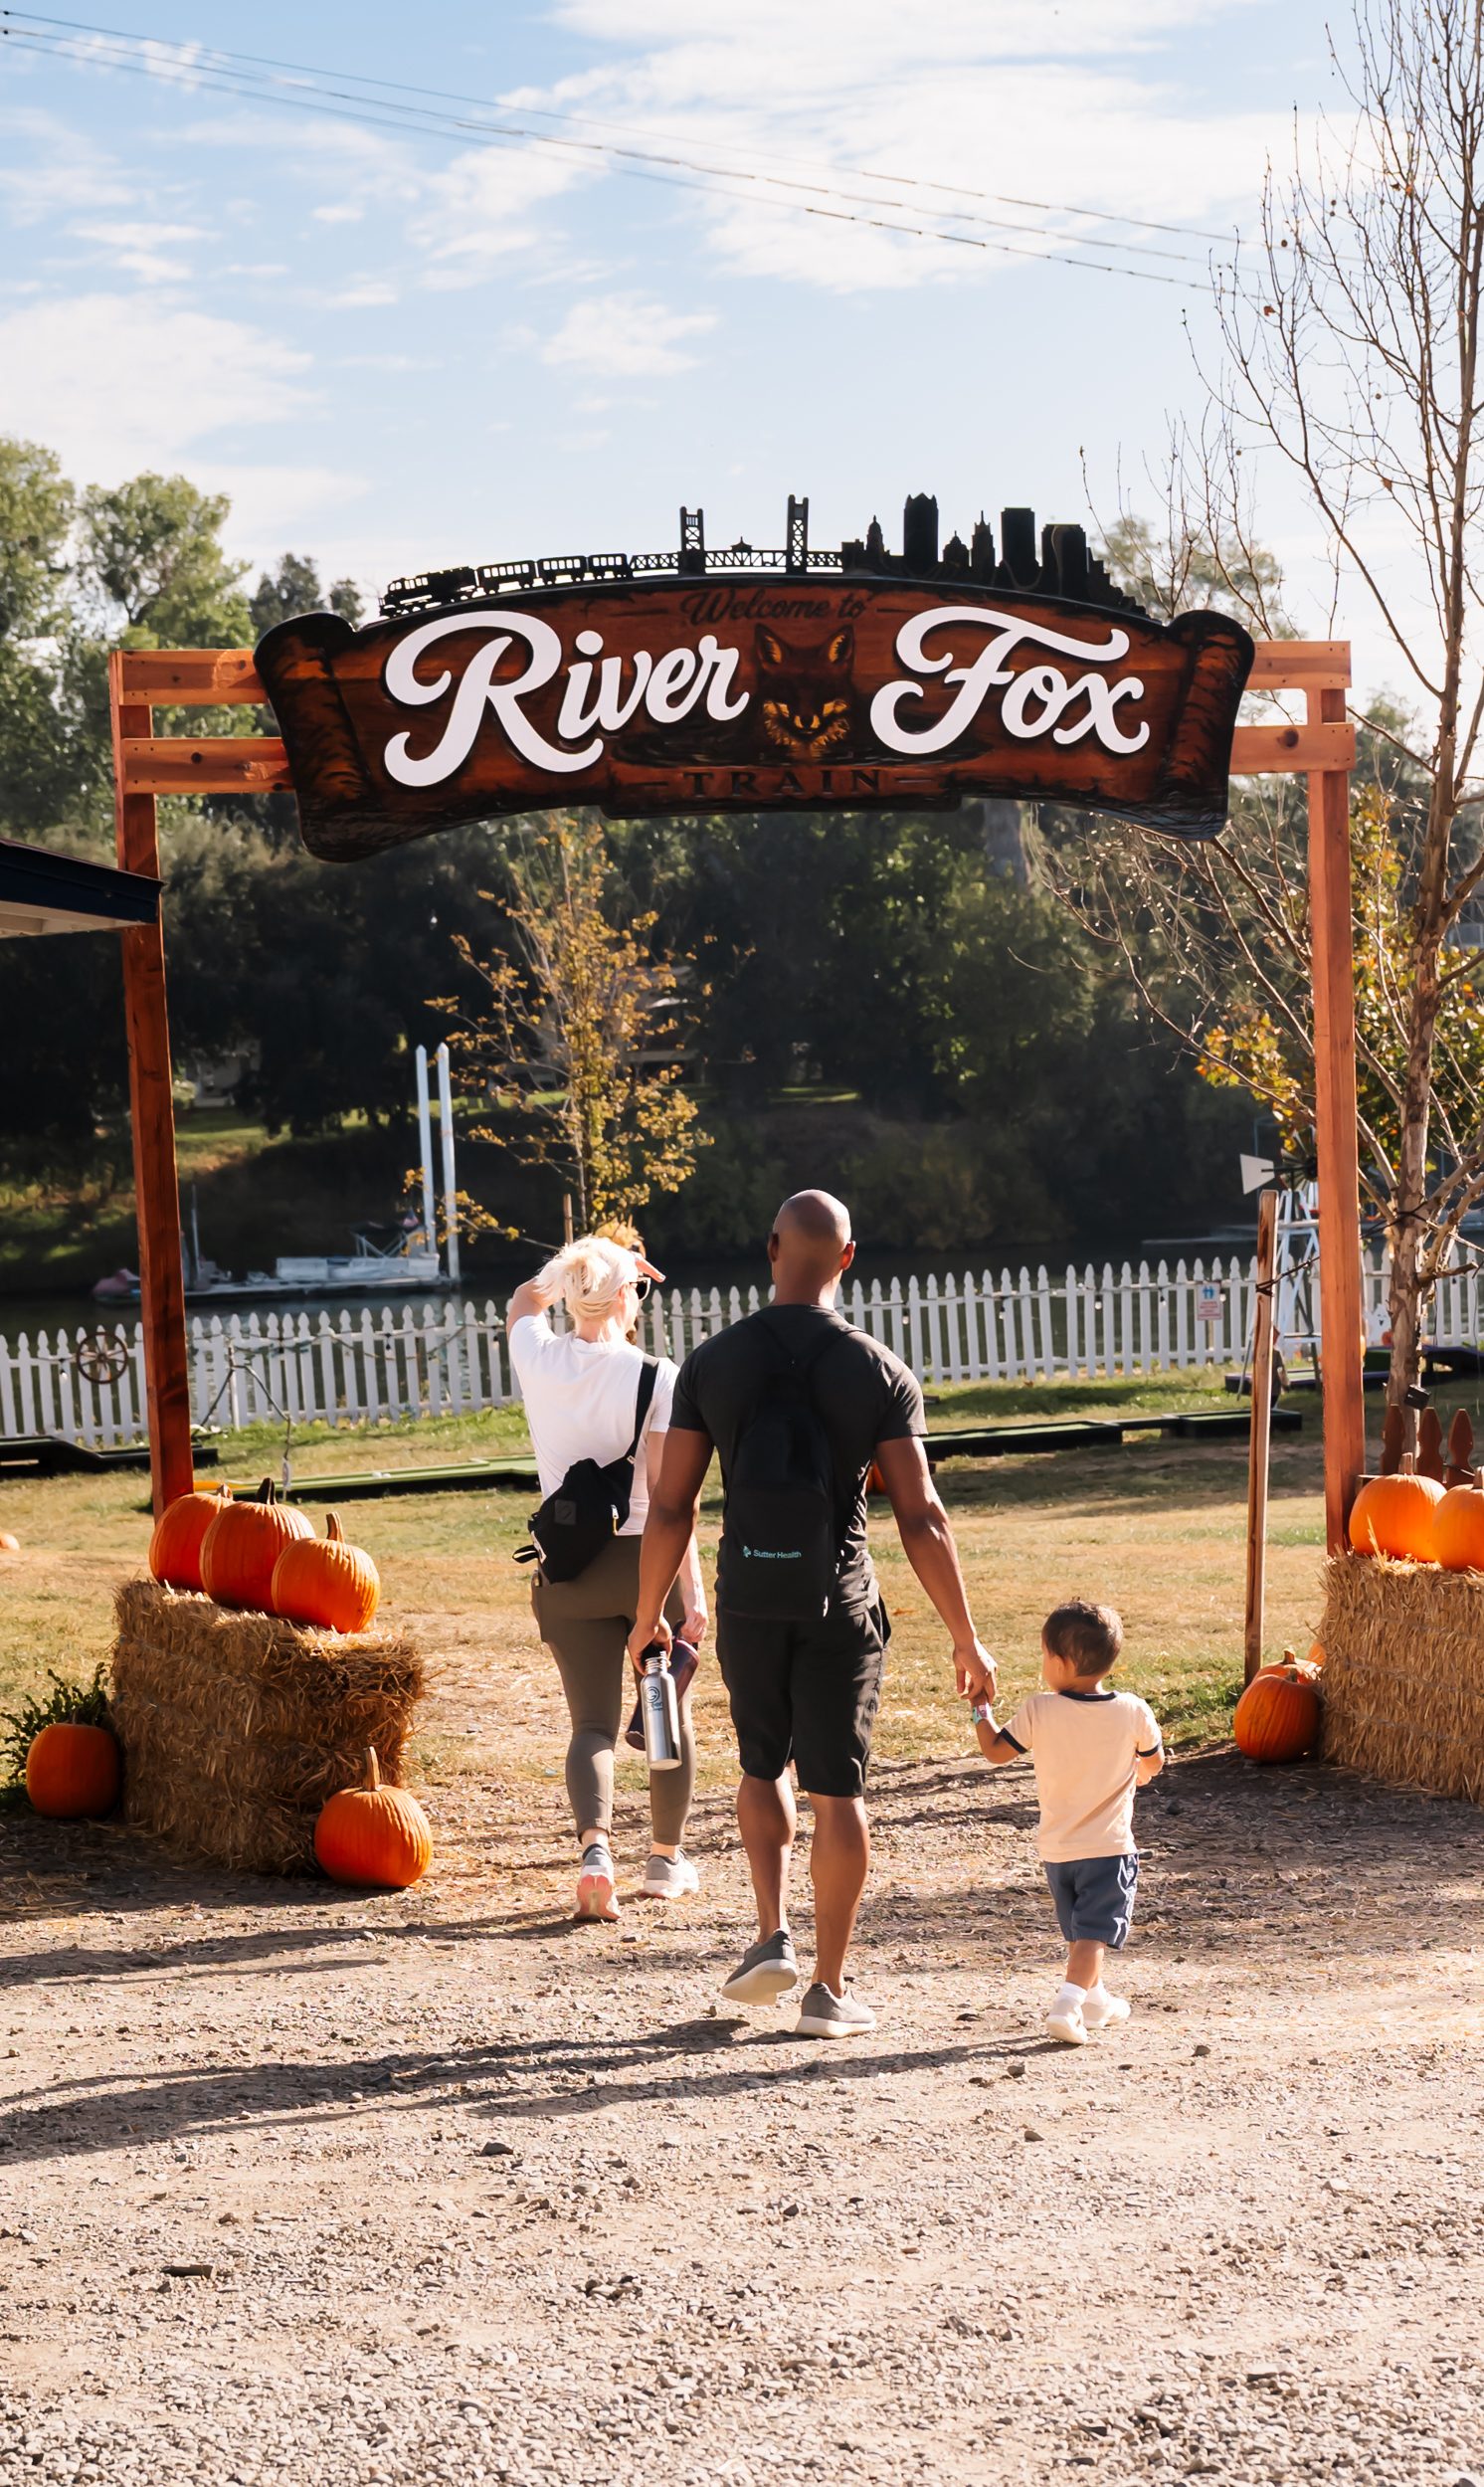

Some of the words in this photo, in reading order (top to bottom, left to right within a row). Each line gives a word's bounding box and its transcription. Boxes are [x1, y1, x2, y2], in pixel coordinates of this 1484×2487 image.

[679, 588, 830, 627] Welcome
[837, 595, 875, 620] to
[384, 610, 750, 787] River
[870, 606, 1150, 754] Fox
[682, 769, 882, 797] TRAIN
[753, 1549, 776, 1559] Sutter
